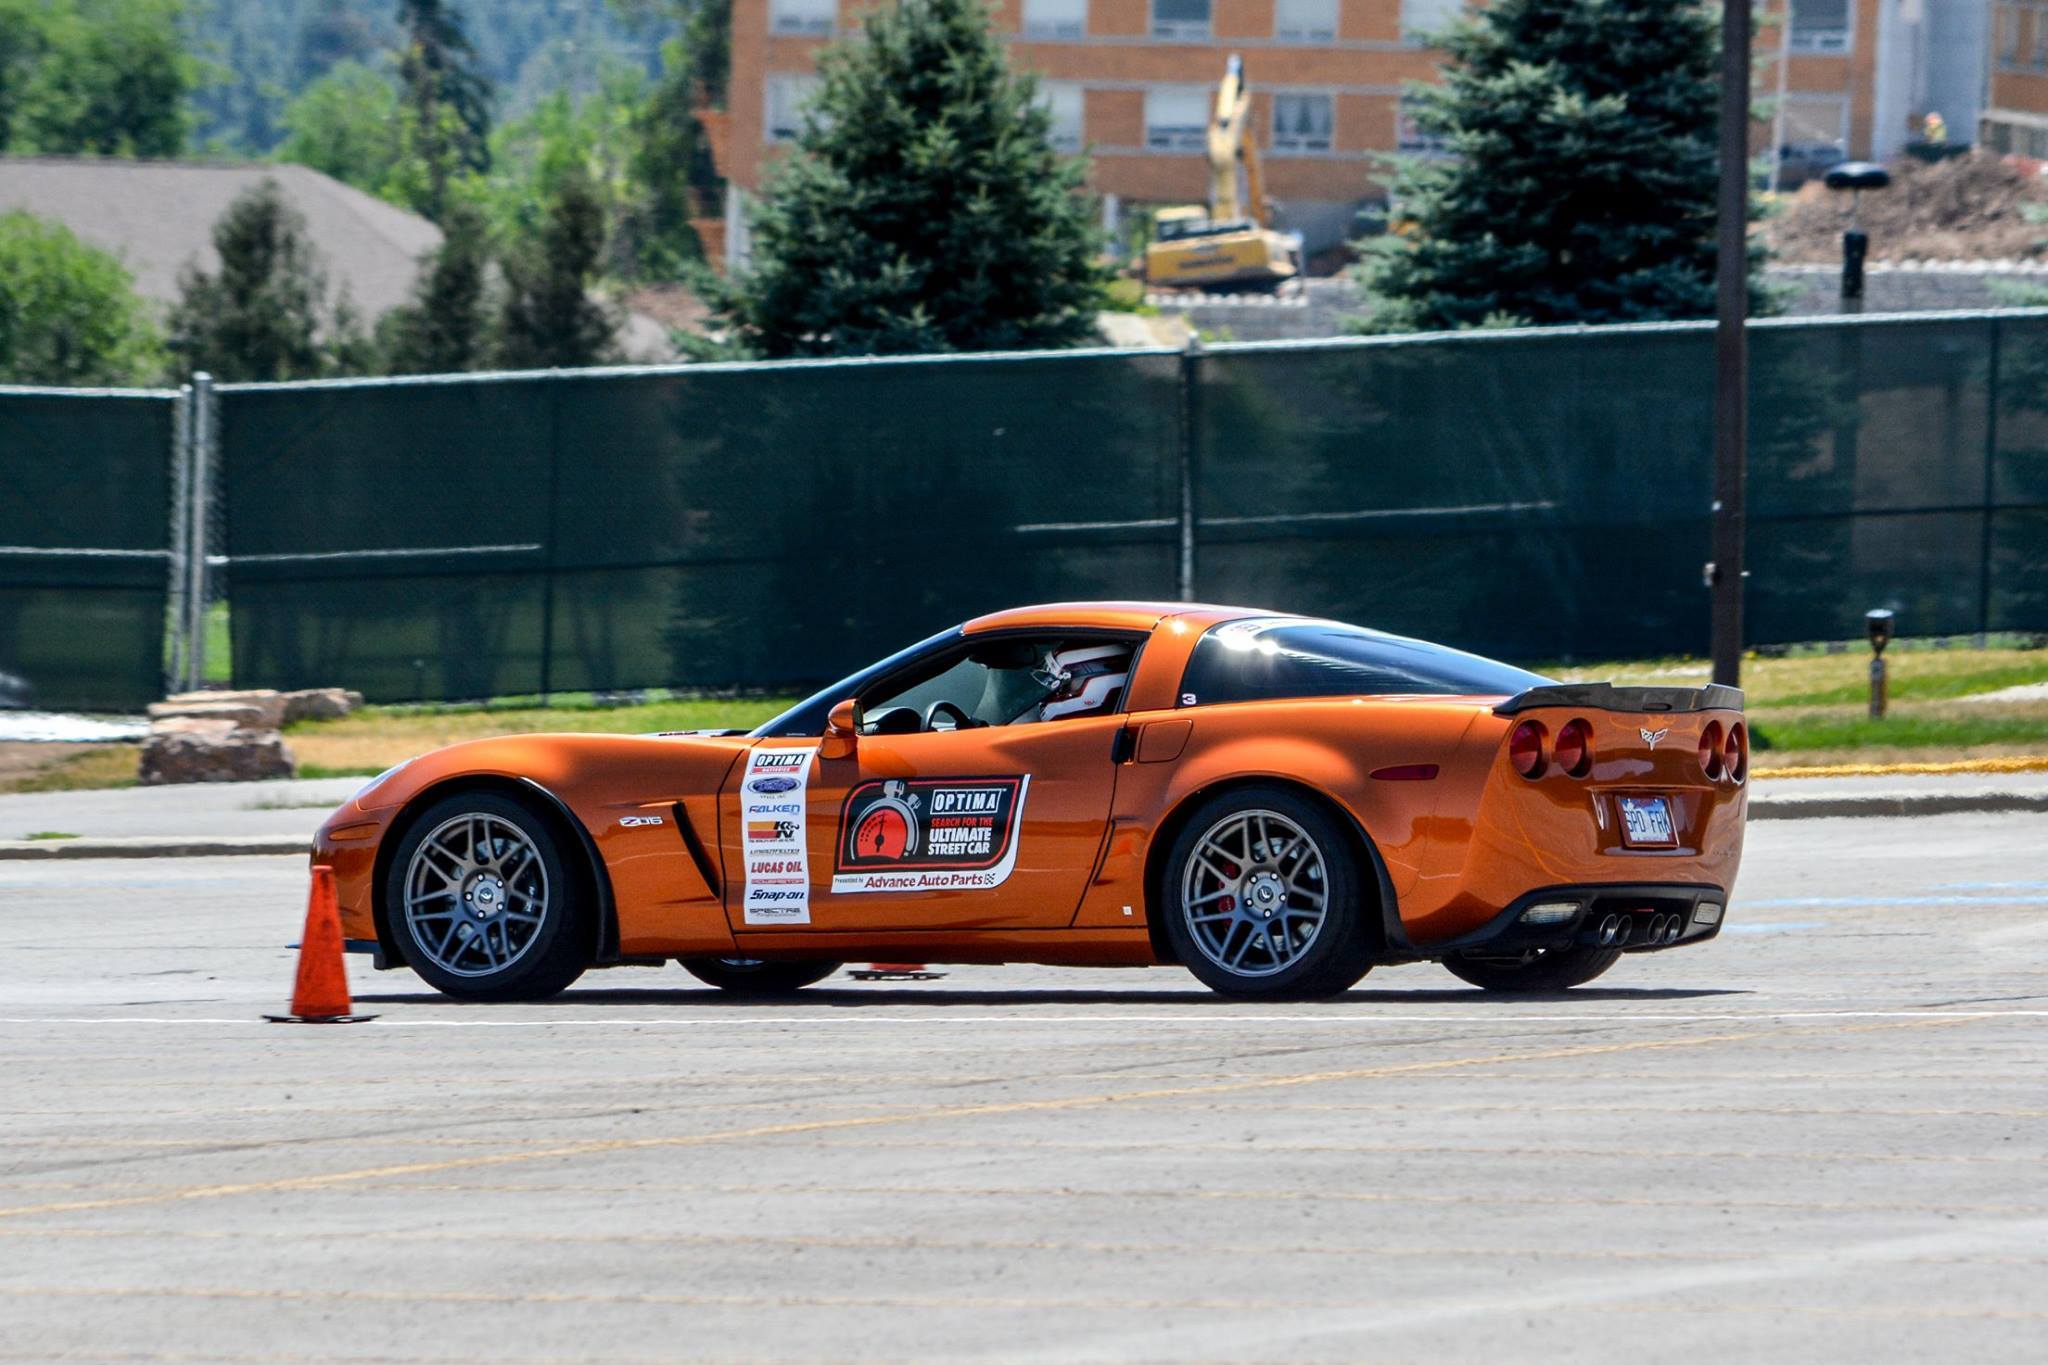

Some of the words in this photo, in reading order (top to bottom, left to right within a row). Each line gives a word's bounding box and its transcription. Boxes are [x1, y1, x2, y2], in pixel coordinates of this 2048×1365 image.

[1182, 693, 1197, 705] 3
[755, 754, 806, 767] OPTIMA
[933, 792, 997, 811] OPTIMA
[749, 804, 801, 813] FALKEN
[931, 817, 960, 828] SEARCH
[961, 816, 978, 827] FOR
[979, 816, 994, 827] THE
[929, 827, 992, 842] ULTIMATE
[928, 843, 967, 855] STREET
[967, 842, 990, 854] CAR
[751, 862, 784, 873] LUCAS
[786, 861, 802, 872] OIL
[864, 876, 916, 888] Advance
[917, 873, 949, 887] Auto
[950, 872, 983, 886] Parts
[750, 889, 806, 902] Snap-on
